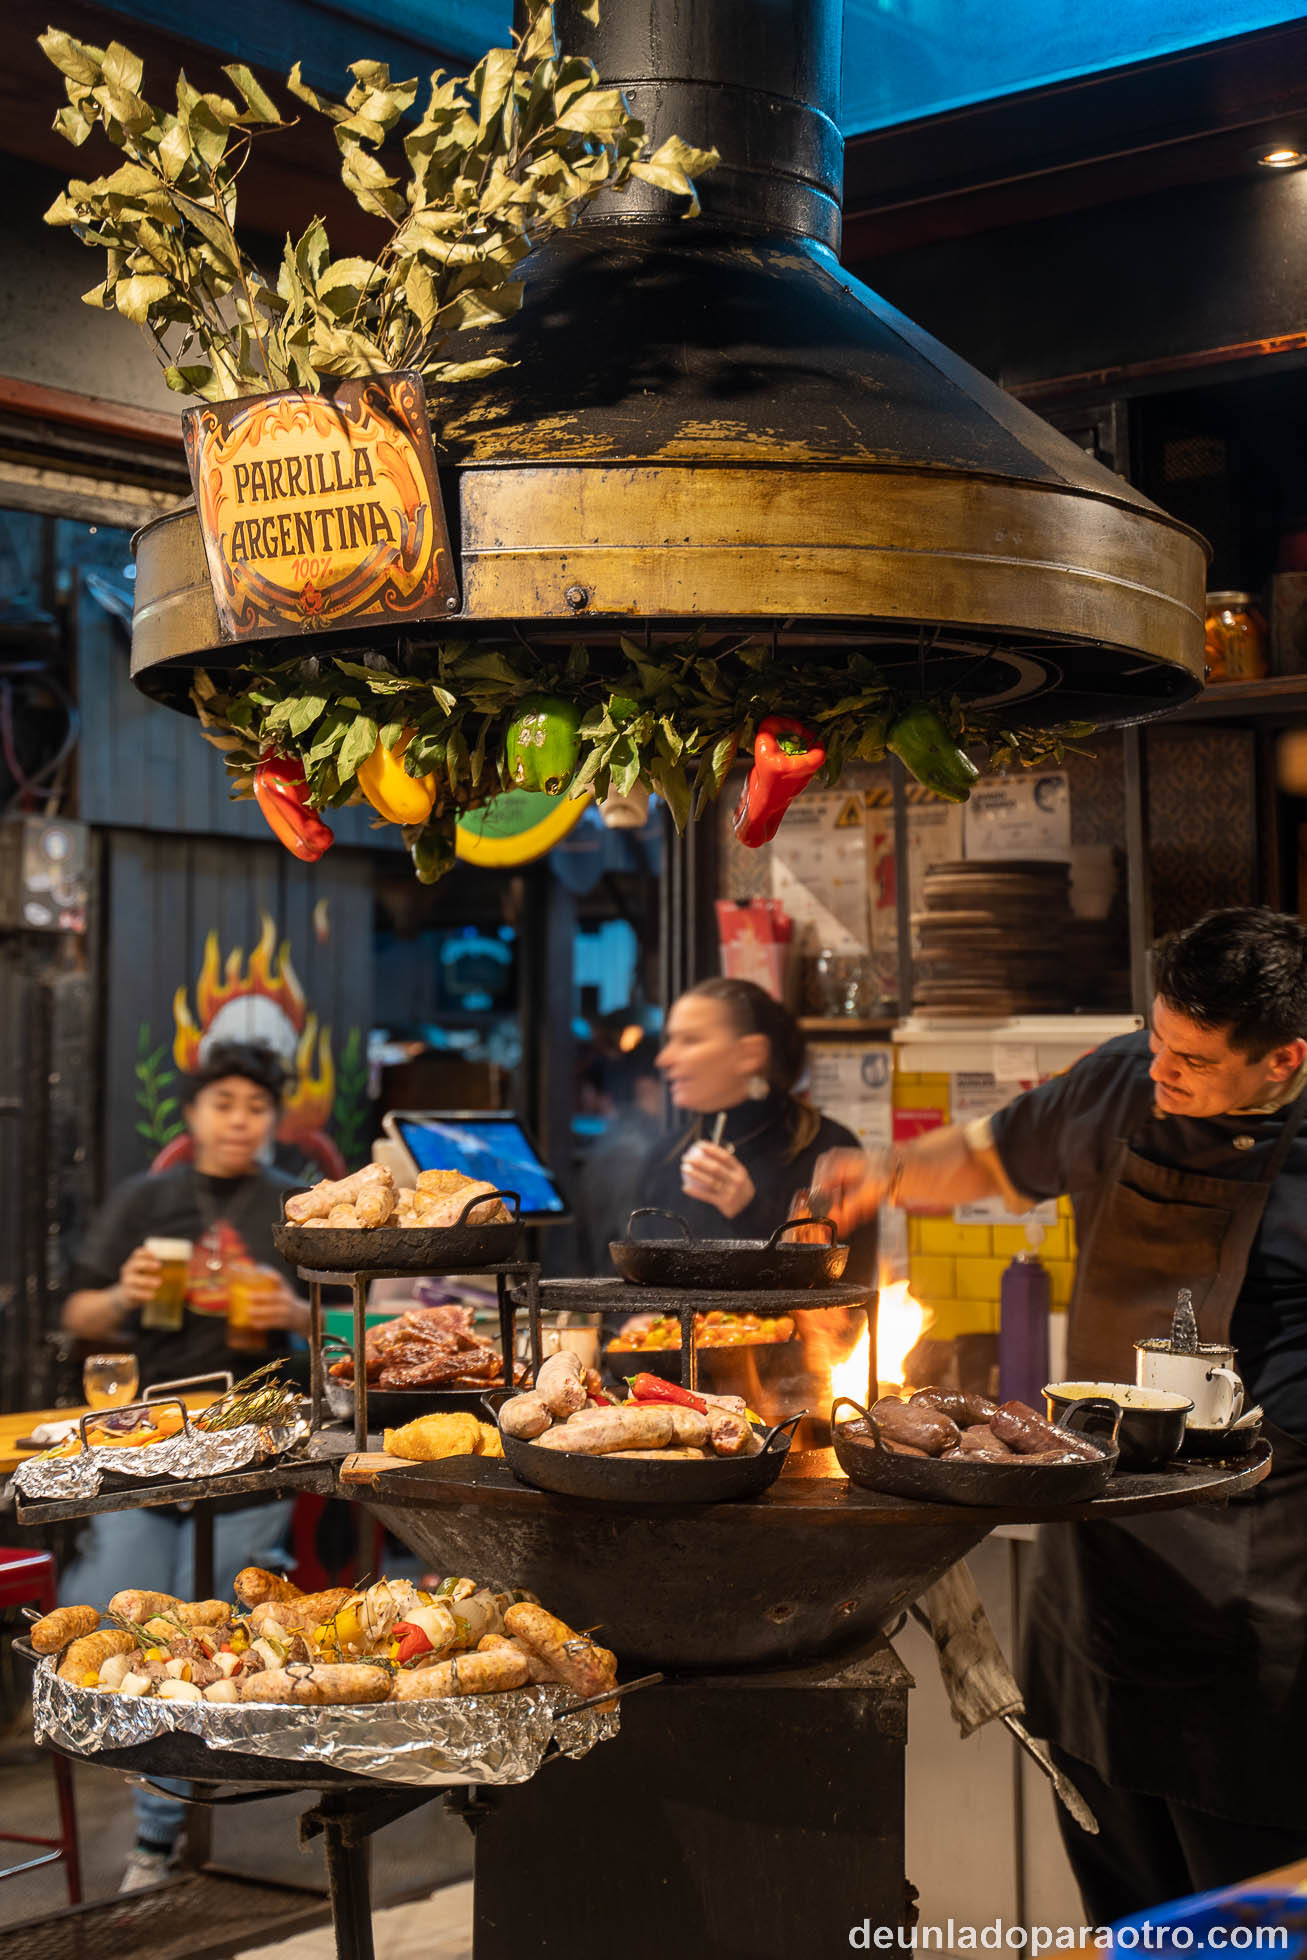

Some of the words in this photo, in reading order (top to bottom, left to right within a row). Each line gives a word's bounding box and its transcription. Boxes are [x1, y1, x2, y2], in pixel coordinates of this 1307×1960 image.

[233, 447, 377, 504] PARRILLA
[231, 501, 397, 563] ARGENTINA
[291, 556, 334, 582] 100%
